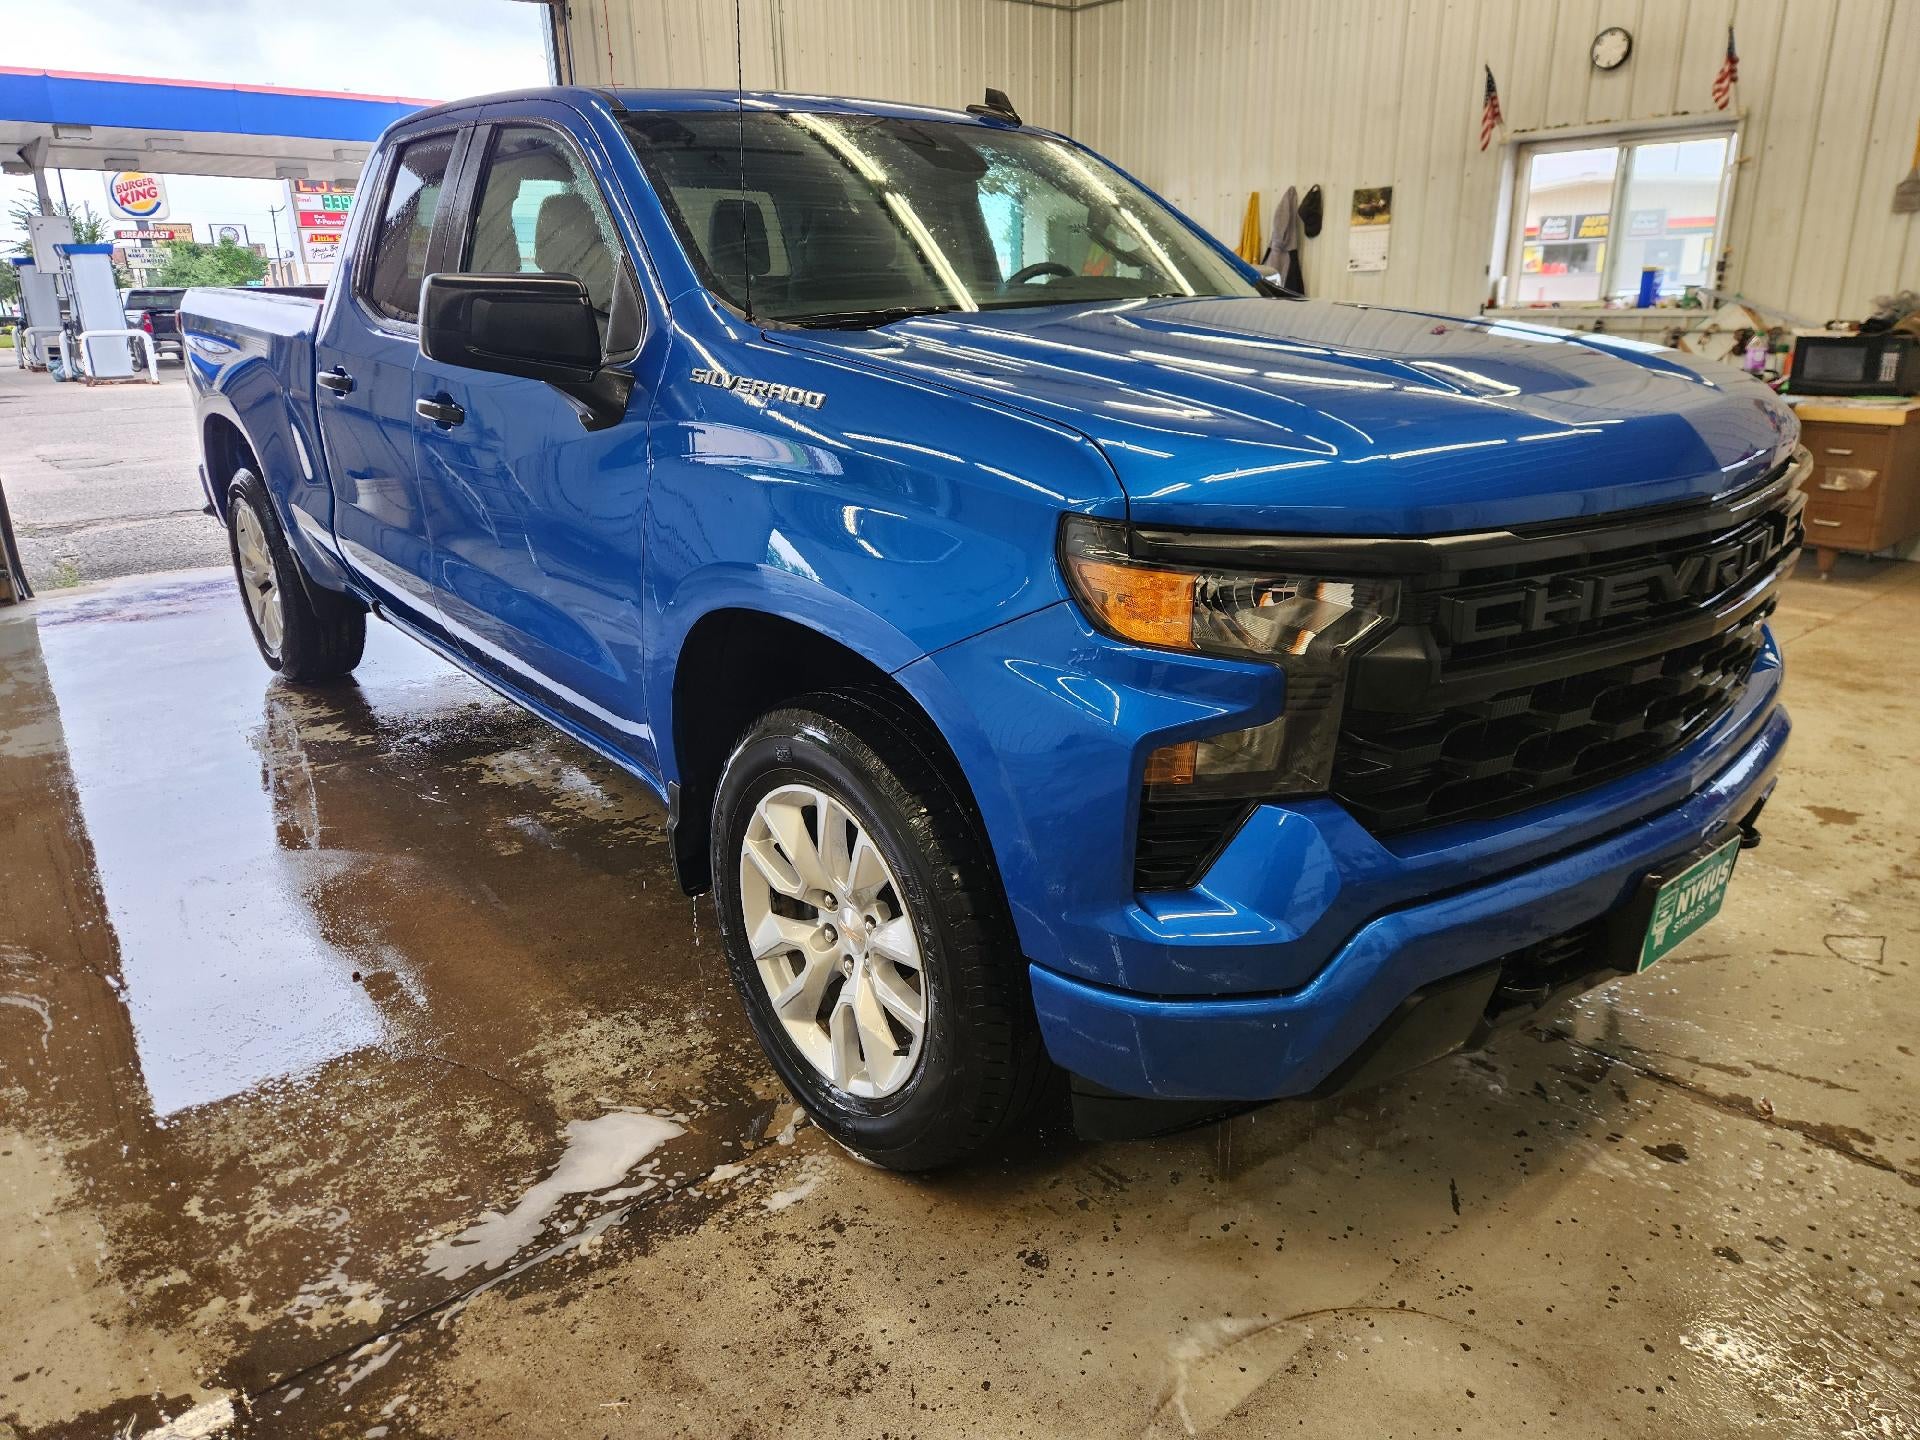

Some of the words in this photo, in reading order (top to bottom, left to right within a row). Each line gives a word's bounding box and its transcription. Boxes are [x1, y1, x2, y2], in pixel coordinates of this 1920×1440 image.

[115, 177, 155, 194] BURGER
[119, 186, 158, 206] KING
[120, 230, 170, 239] BREAKFAST
[689, 368, 827, 409] SILVERADO
[1441, 506, 1804, 645] CHEVROLE
[1676, 858, 1731, 918] NYHUS
